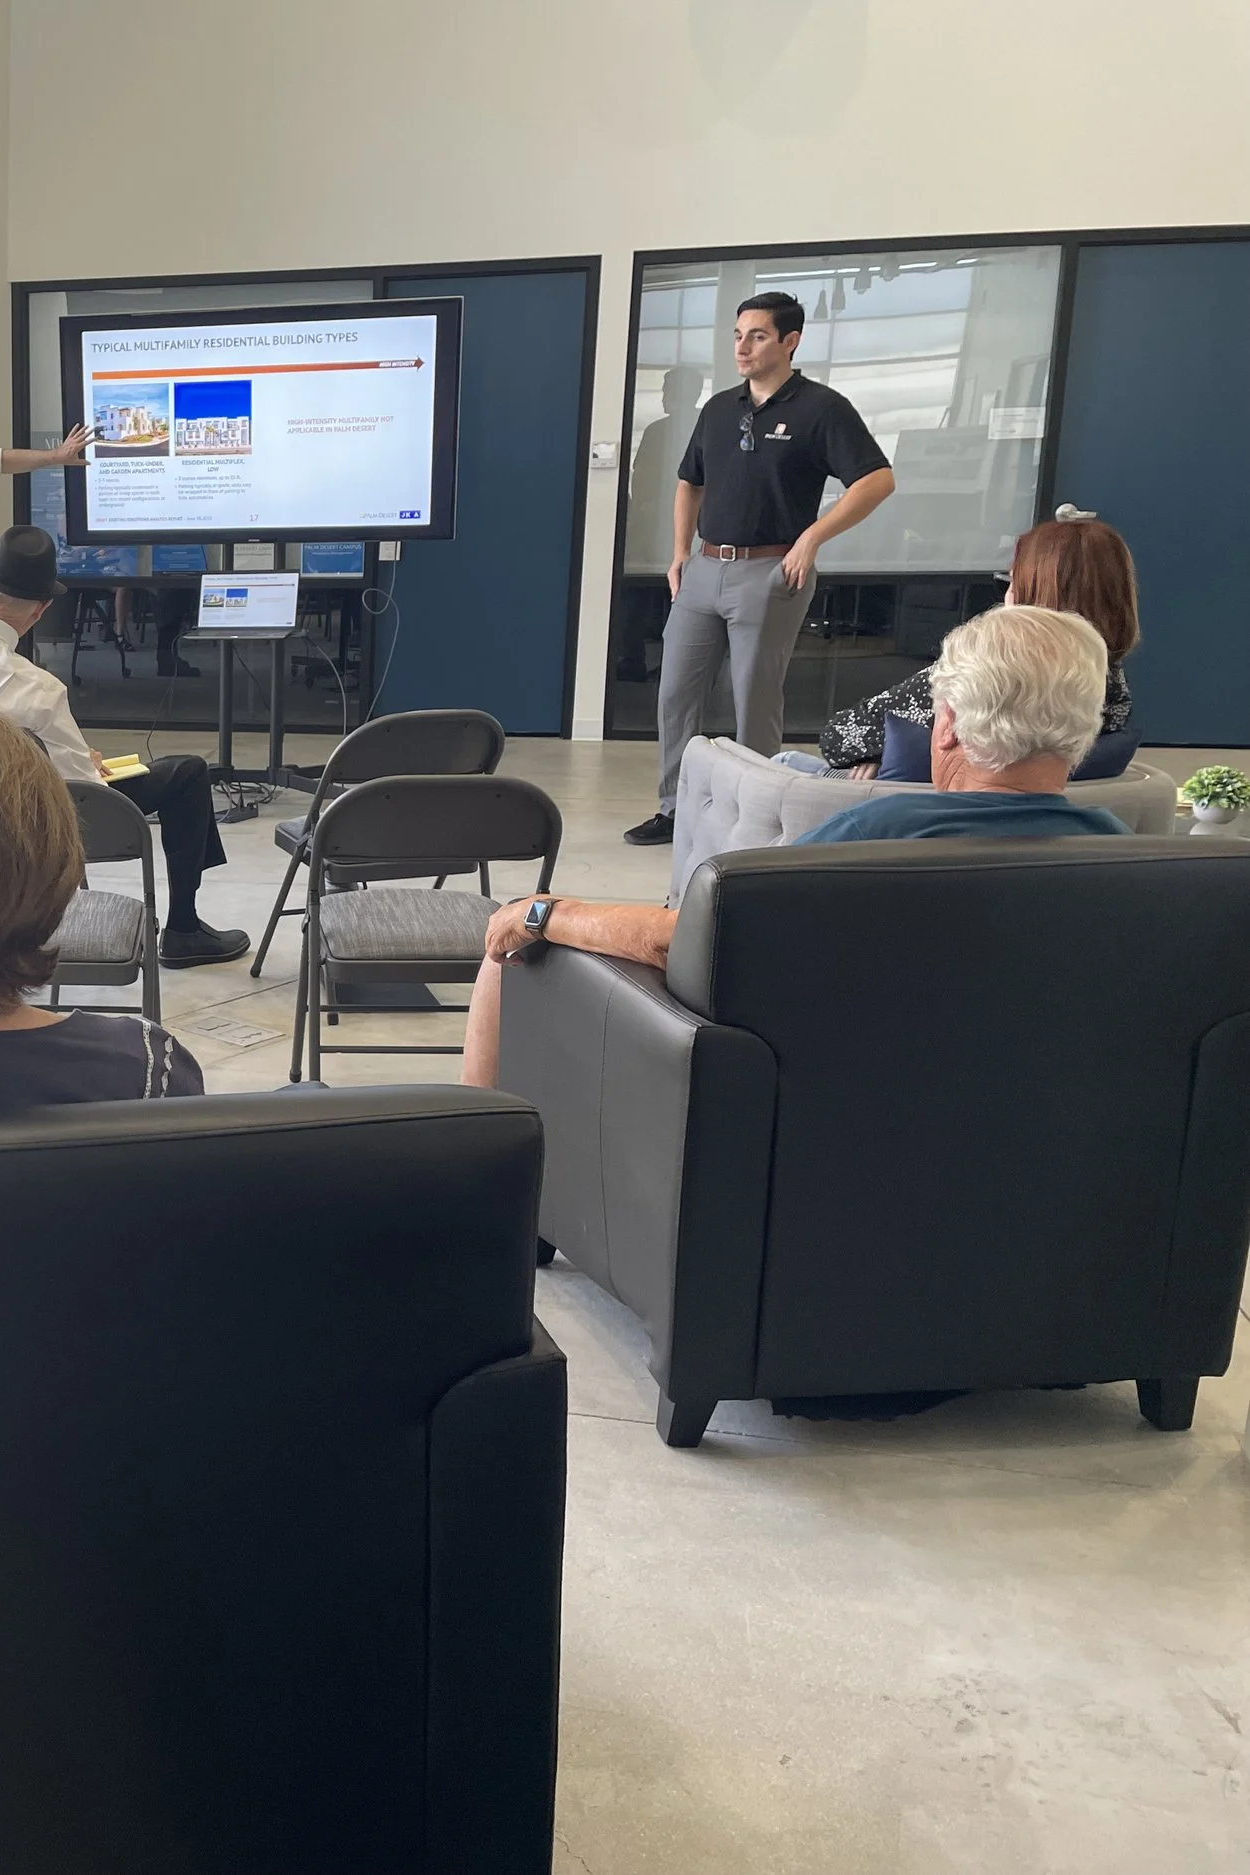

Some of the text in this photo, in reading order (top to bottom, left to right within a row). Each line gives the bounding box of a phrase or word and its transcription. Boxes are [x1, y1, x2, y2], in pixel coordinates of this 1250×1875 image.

[91, 332, 358, 353] TYPICAL MULTIFAMILY RESIDENTIAL BUILDING TYPES
[287, 426, 323, 434] APPLICABLE
